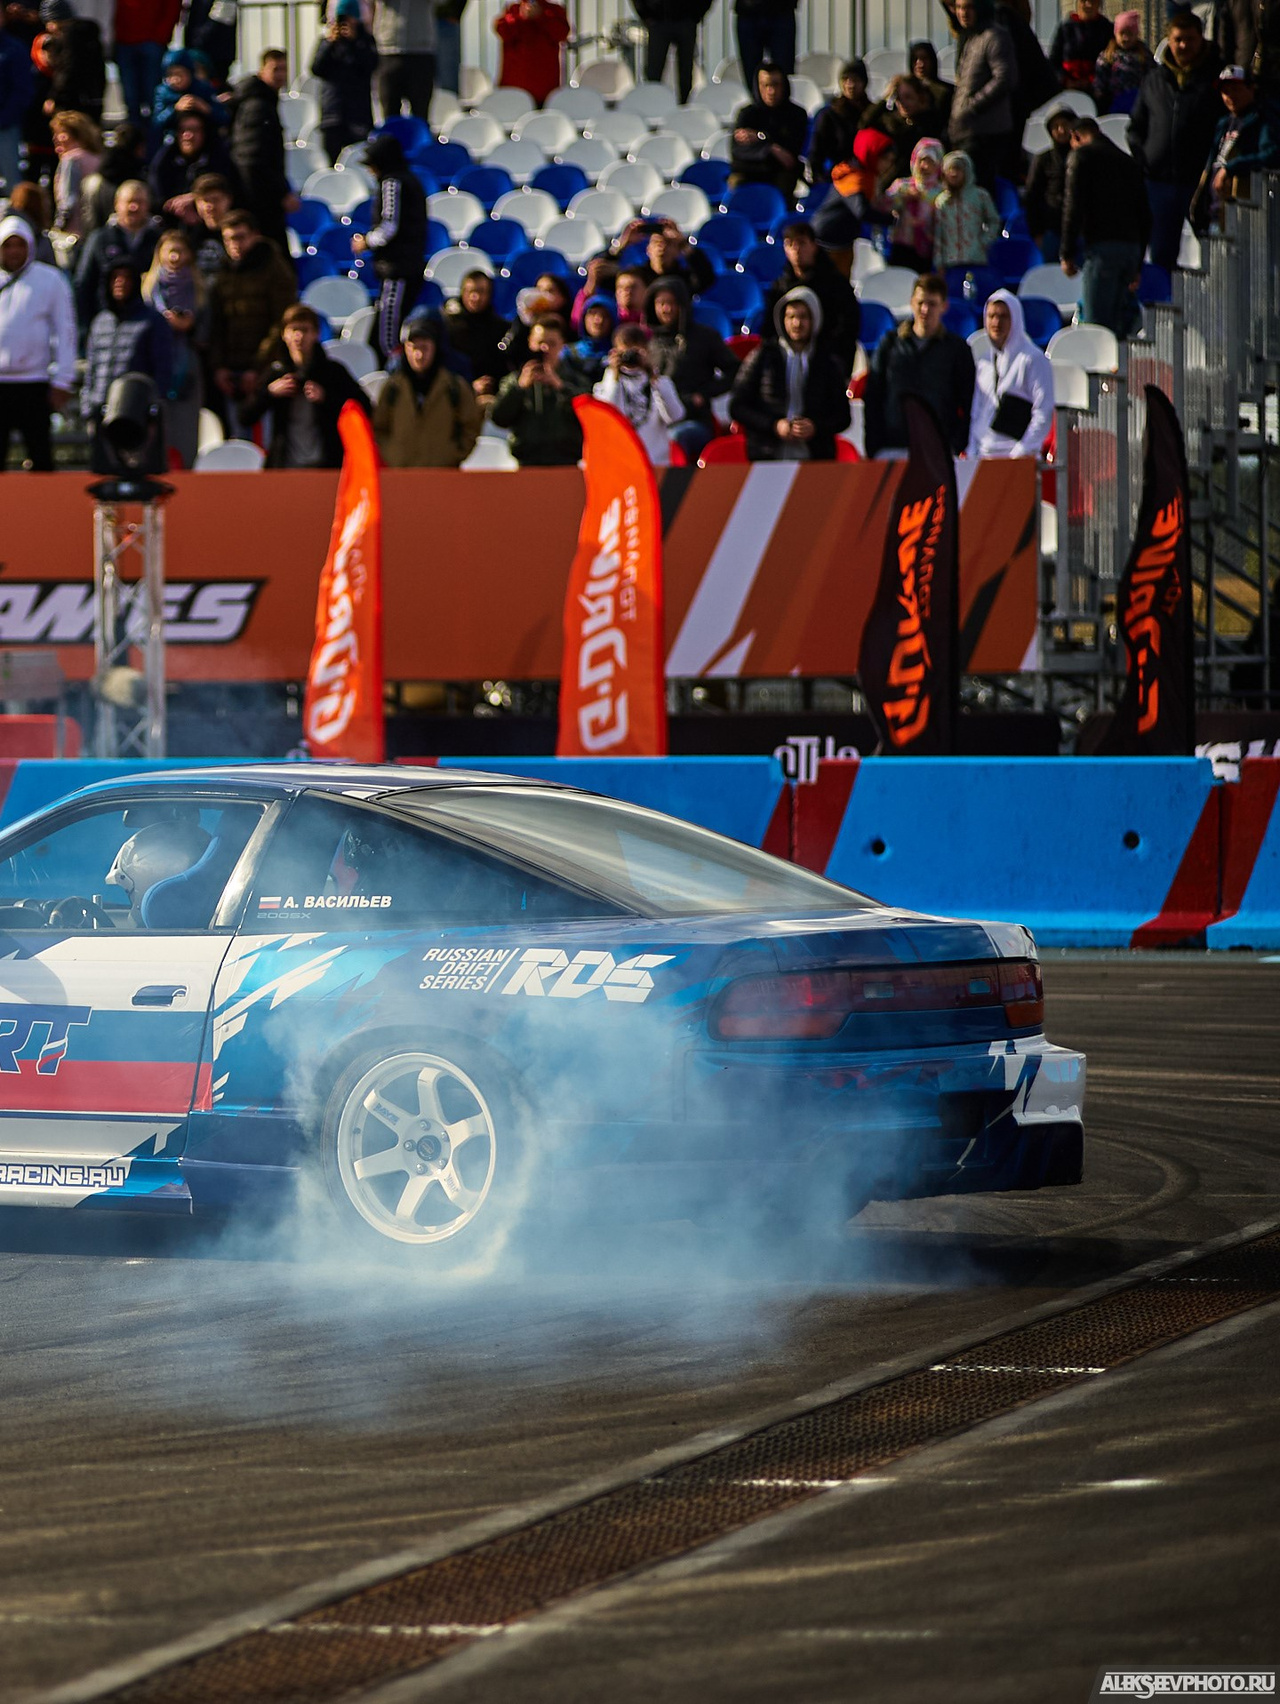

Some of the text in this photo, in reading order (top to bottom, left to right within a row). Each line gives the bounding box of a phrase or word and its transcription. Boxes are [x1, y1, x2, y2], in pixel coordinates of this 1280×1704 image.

[284, 895, 392, 909] А. ВАСИЛЬЕВ
[422, 948, 510, 961] RUSSIAN
[438, 962, 500, 976] DRIFT
[501, 948, 676, 1003] RDS
[420, 975, 488, 990] SERIES
